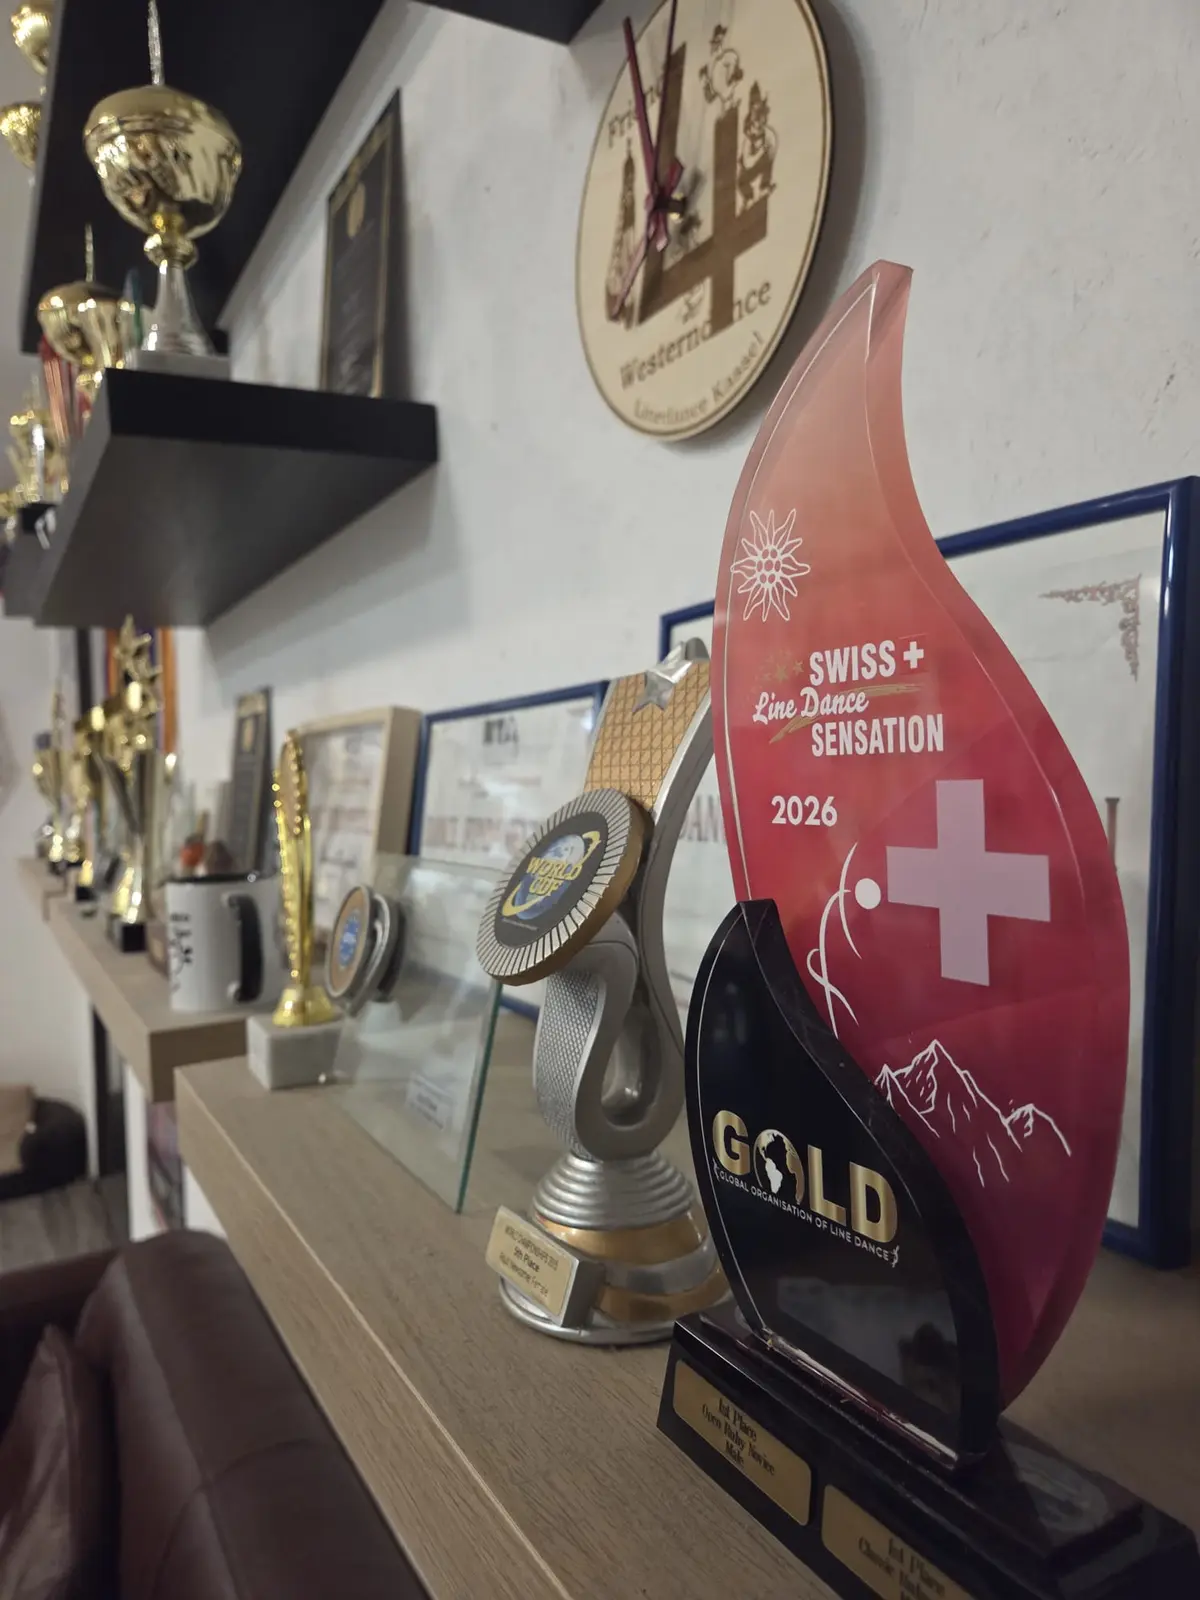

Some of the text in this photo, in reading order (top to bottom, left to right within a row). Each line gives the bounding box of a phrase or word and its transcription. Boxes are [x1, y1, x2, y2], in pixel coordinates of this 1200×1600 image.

[809, 640, 896, 686] SWISS
[752, 686, 869, 724] Line Dance
[811, 713, 944, 757] SENSATION
[771, 795, 838, 827] 2026
[526, 856, 583, 880] WORLD
[712, 1109, 898, 1243] GOLD
[719, 1170, 889, 1262] GLOBAL ORGANISATION OF LINE DANCE
